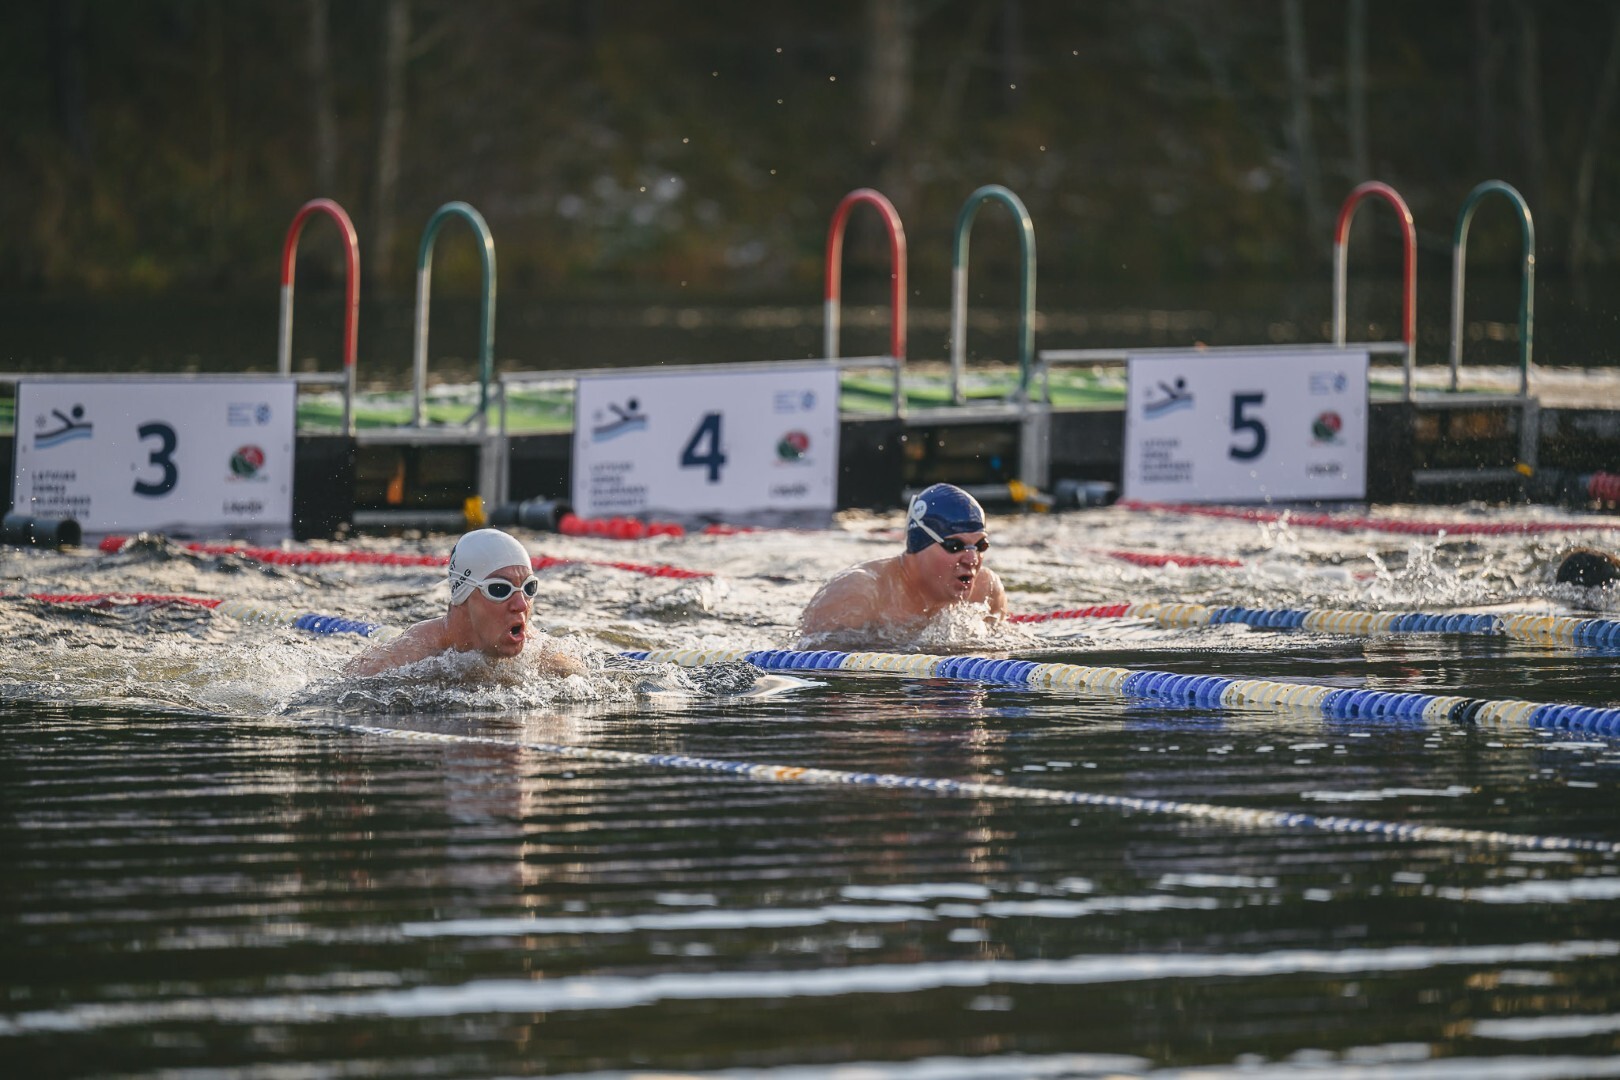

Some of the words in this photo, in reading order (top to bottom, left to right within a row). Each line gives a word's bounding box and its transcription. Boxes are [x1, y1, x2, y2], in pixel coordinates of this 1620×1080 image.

[133, 420, 178, 496] 3
[680, 411, 727, 483] 4
[1228, 391, 1268, 462] 5
